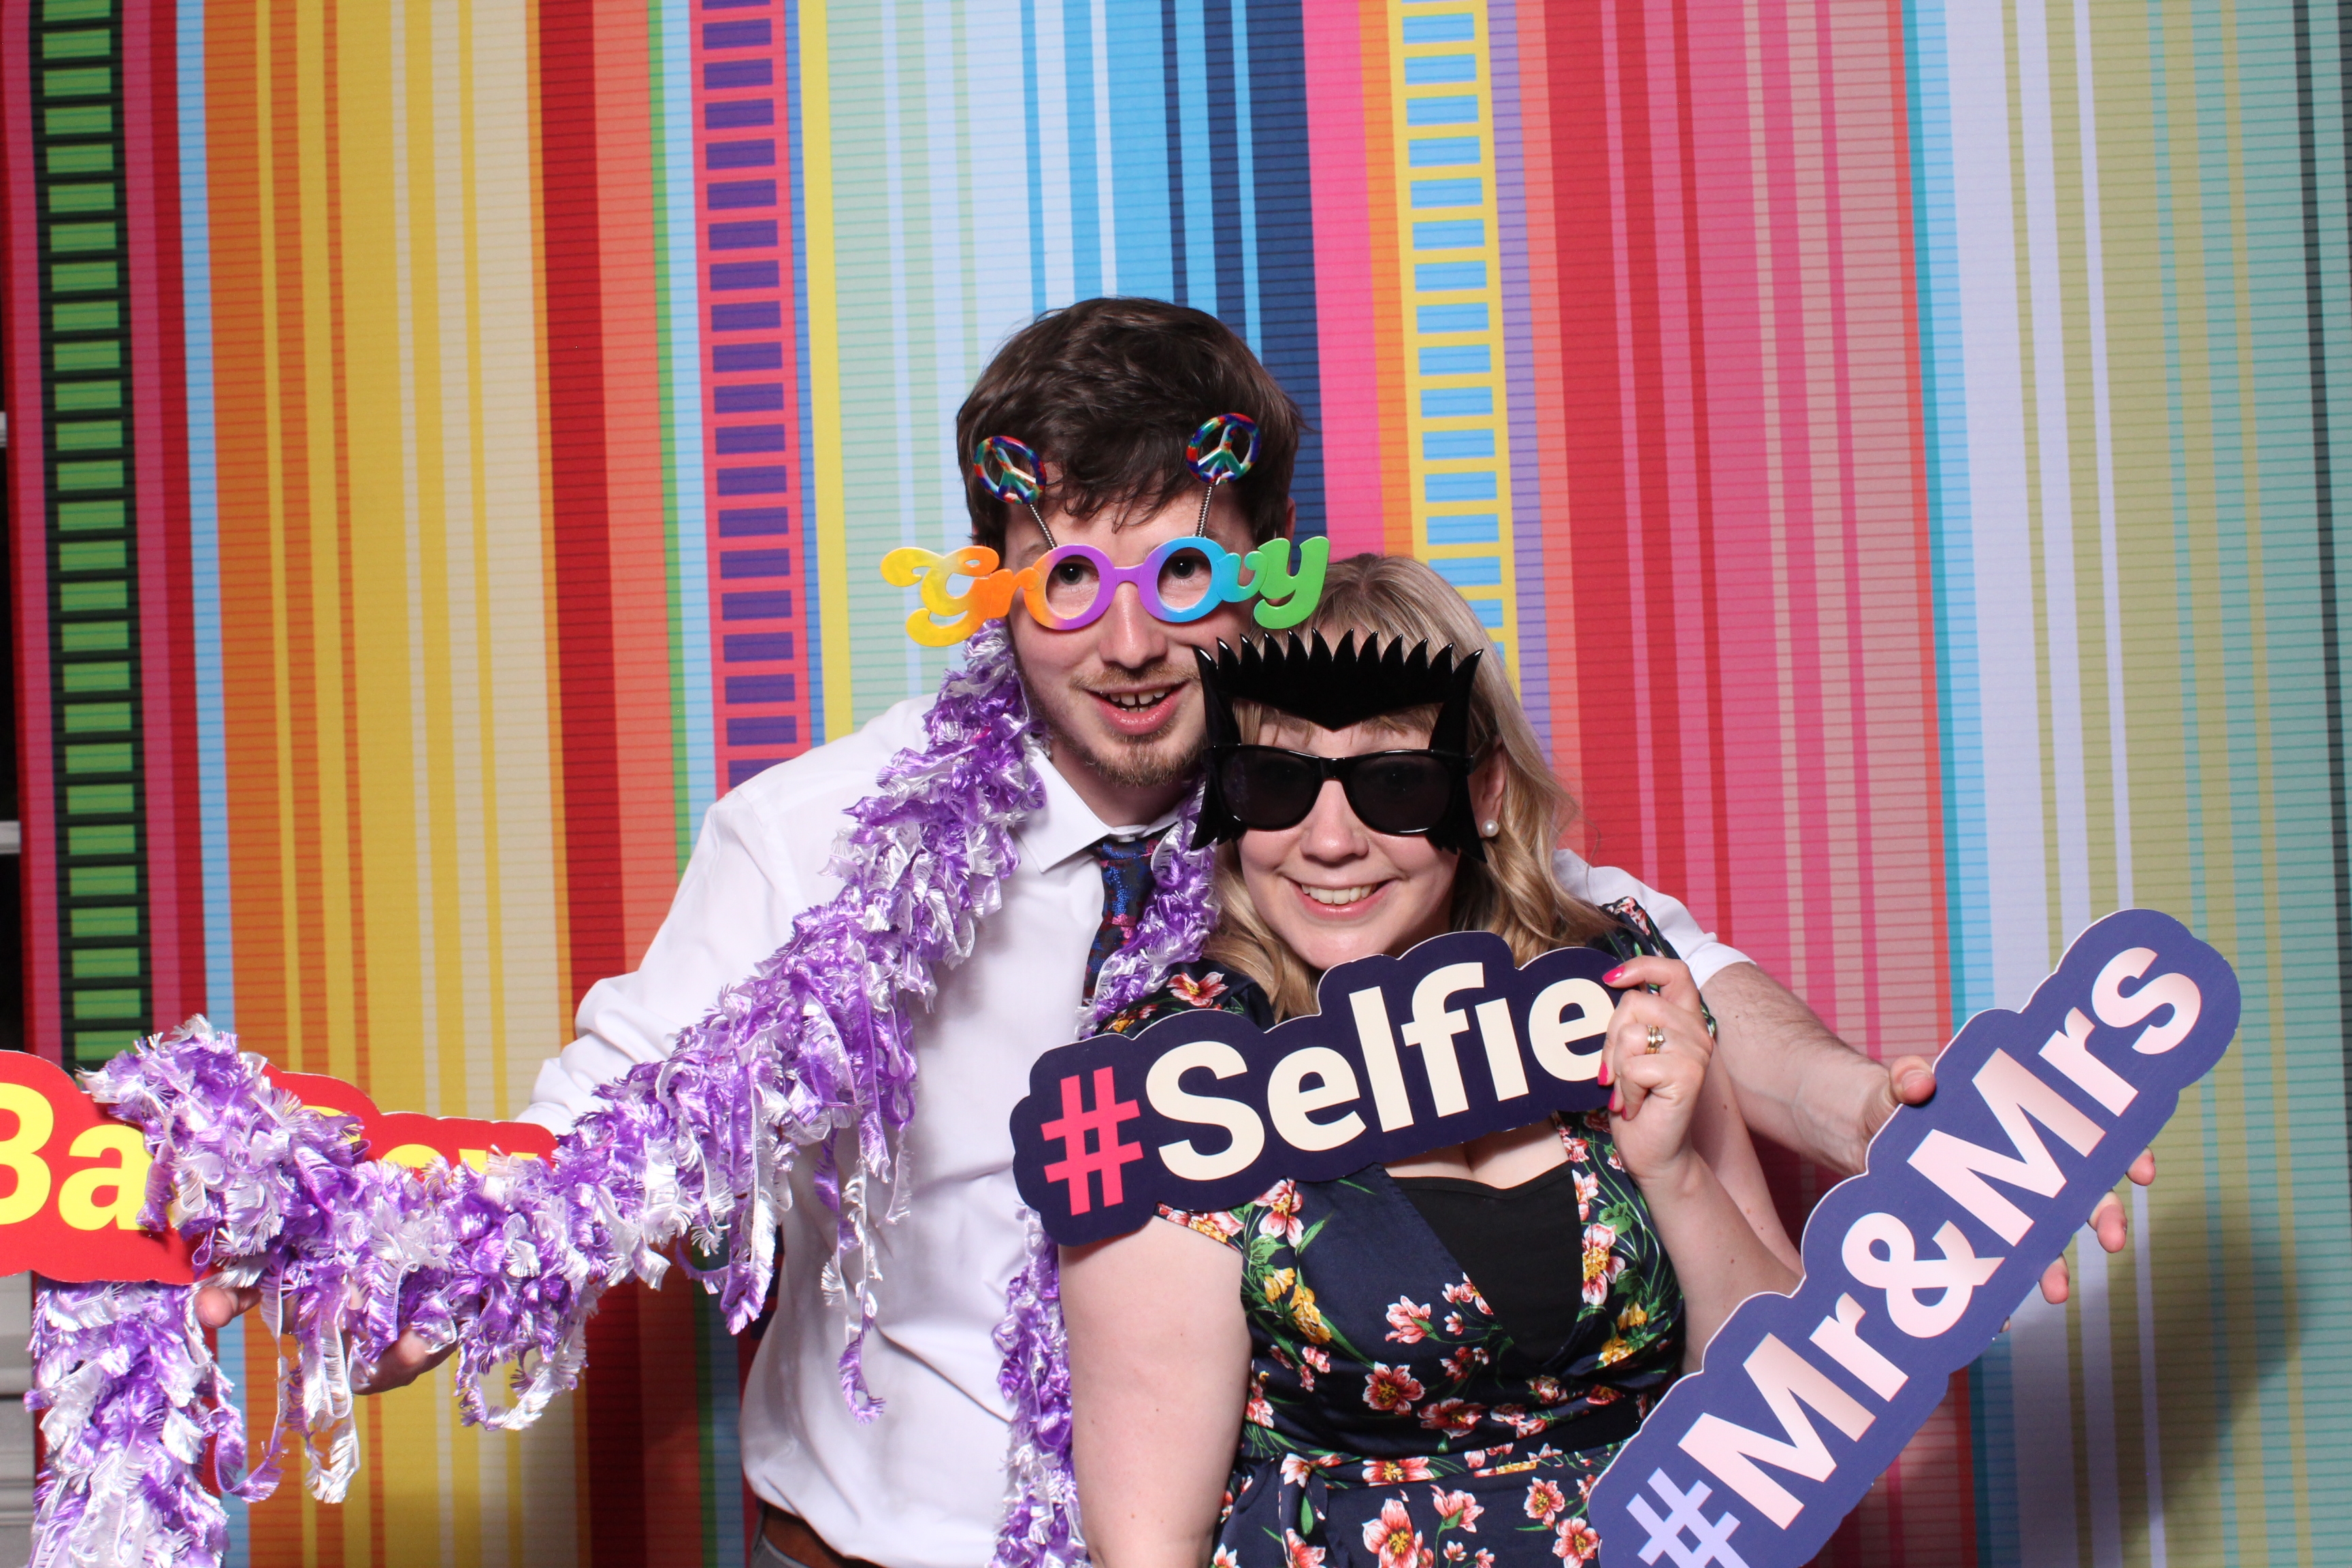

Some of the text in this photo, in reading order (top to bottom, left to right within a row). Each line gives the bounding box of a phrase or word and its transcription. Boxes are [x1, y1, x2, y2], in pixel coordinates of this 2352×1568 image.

[0, 1083, 178, 1231] Ba
[1040, 962, 1616, 1216] #Selfie
[1626, 947, 2202, 1568] #Mr&Mrs
